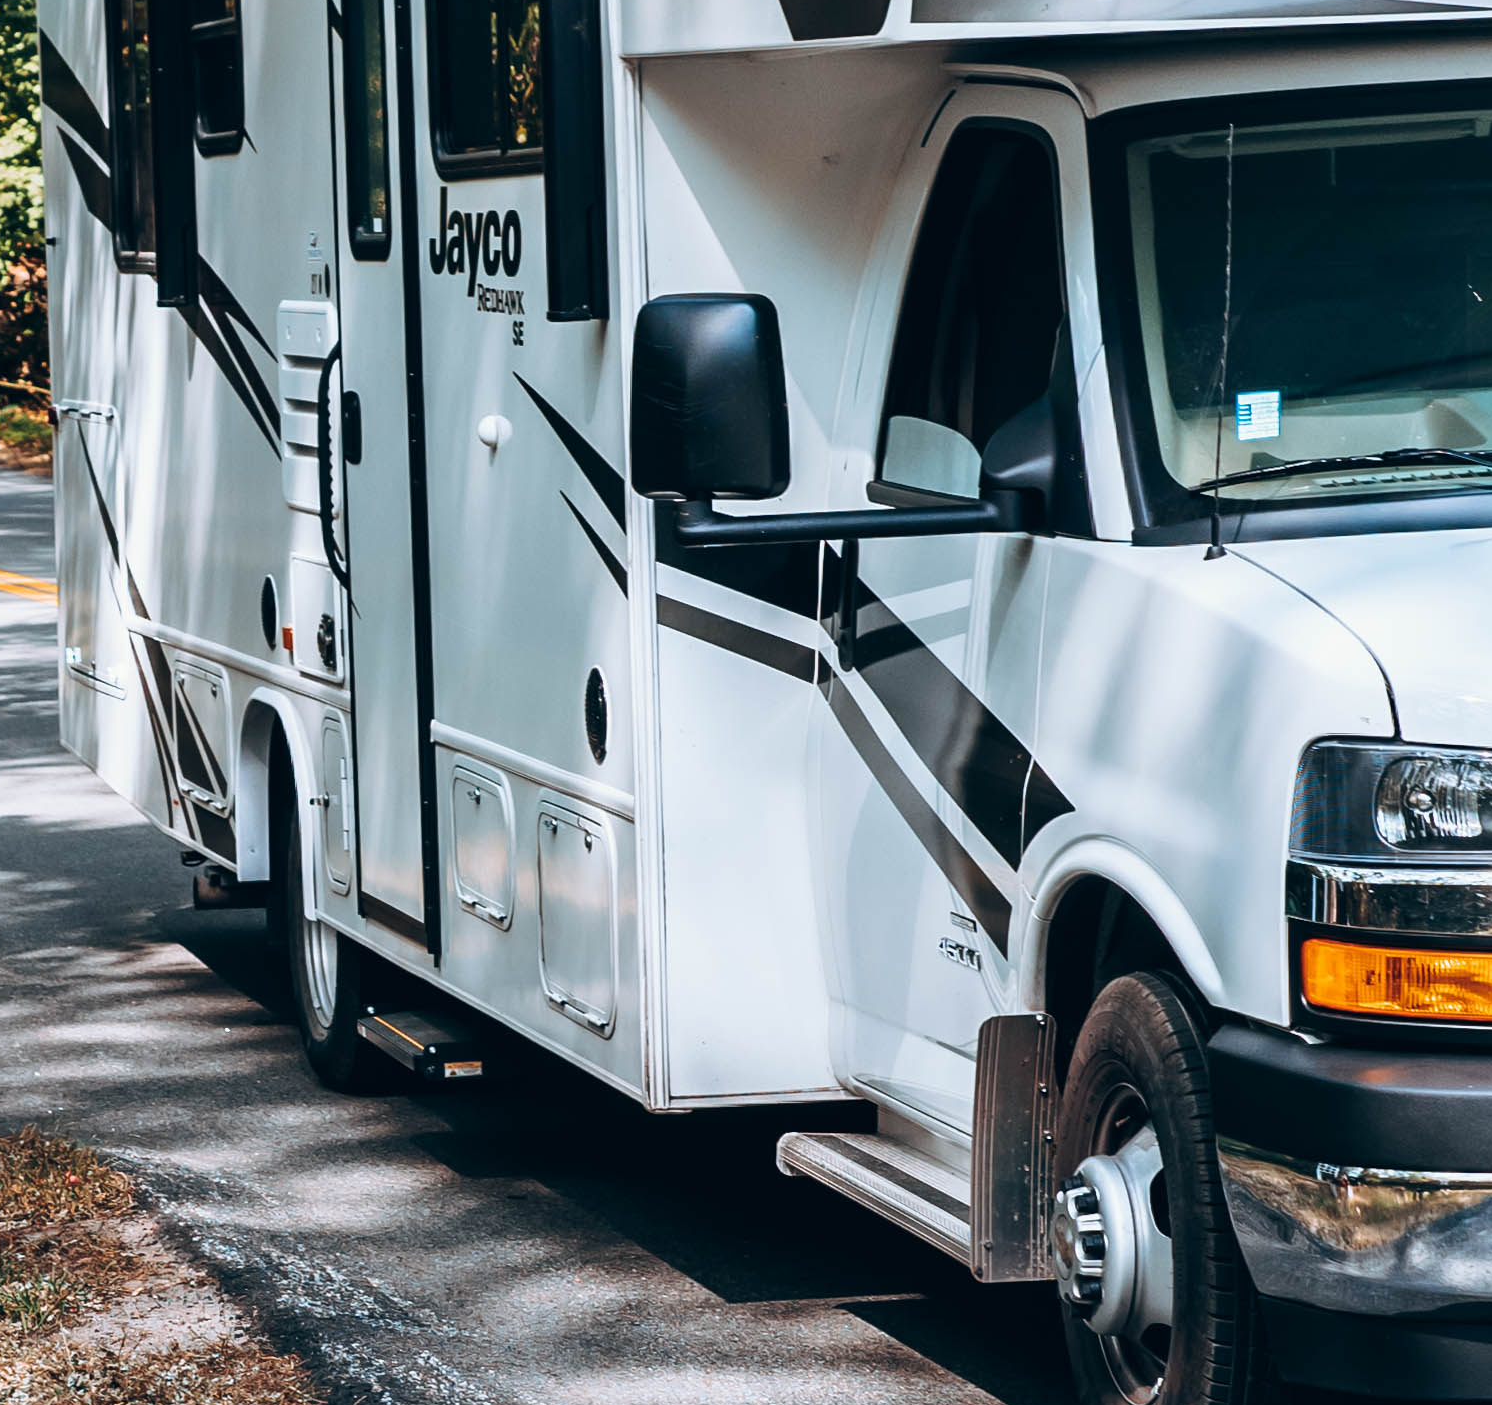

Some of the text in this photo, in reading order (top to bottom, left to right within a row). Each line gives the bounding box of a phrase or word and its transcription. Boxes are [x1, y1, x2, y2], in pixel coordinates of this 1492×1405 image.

[429, 186, 522, 297] Jayco
[477, 283, 525, 315] REDHAWK
[512, 320, 524, 346] SE
